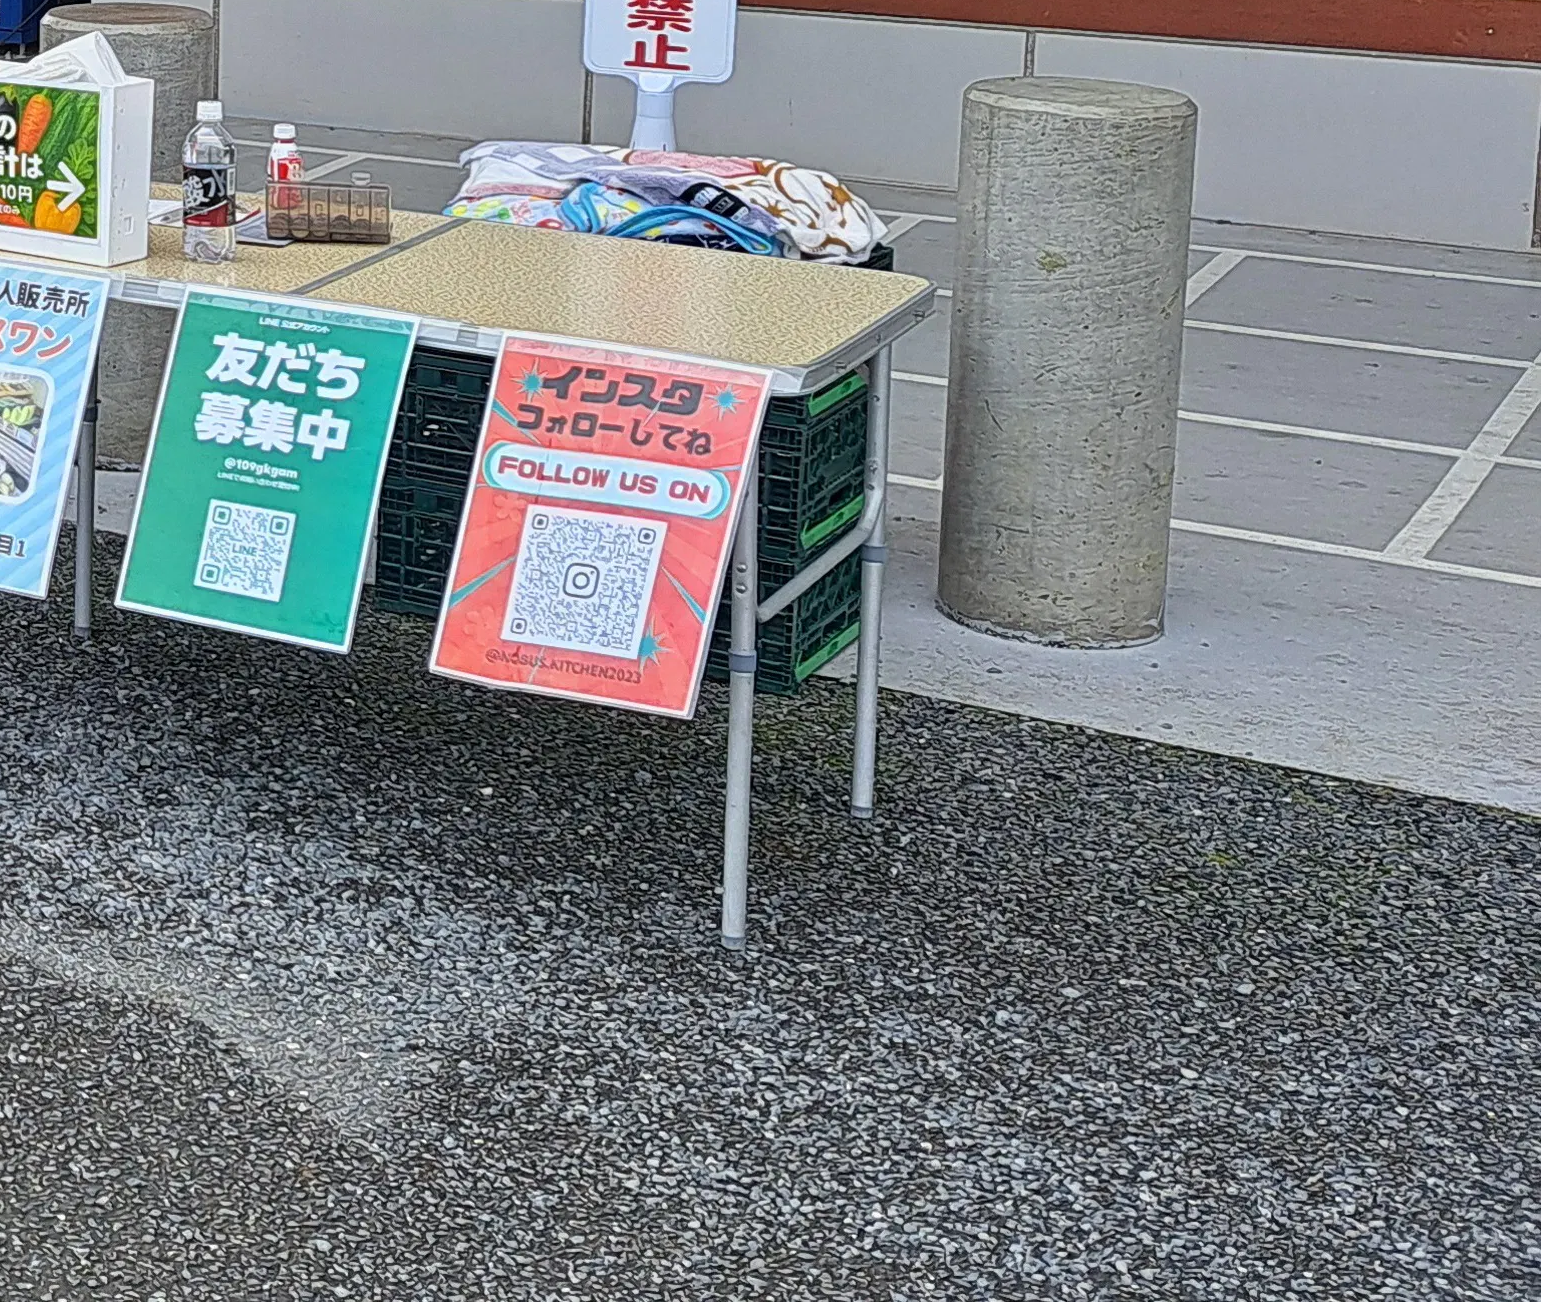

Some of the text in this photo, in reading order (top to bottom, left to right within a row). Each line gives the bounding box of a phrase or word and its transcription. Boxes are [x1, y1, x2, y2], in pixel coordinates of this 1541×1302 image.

[259, 316, 280, 328] LINE
[205, 332, 366, 400] 友だち
[541, 365, 704, 415] インスタ
[193, 391, 351, 461] 募集中
[516, 403, 712, 456] フォローしてね
[498, 455, 711, 503] FOLLOW US ON
[231, 543, 258, 557] LINE
